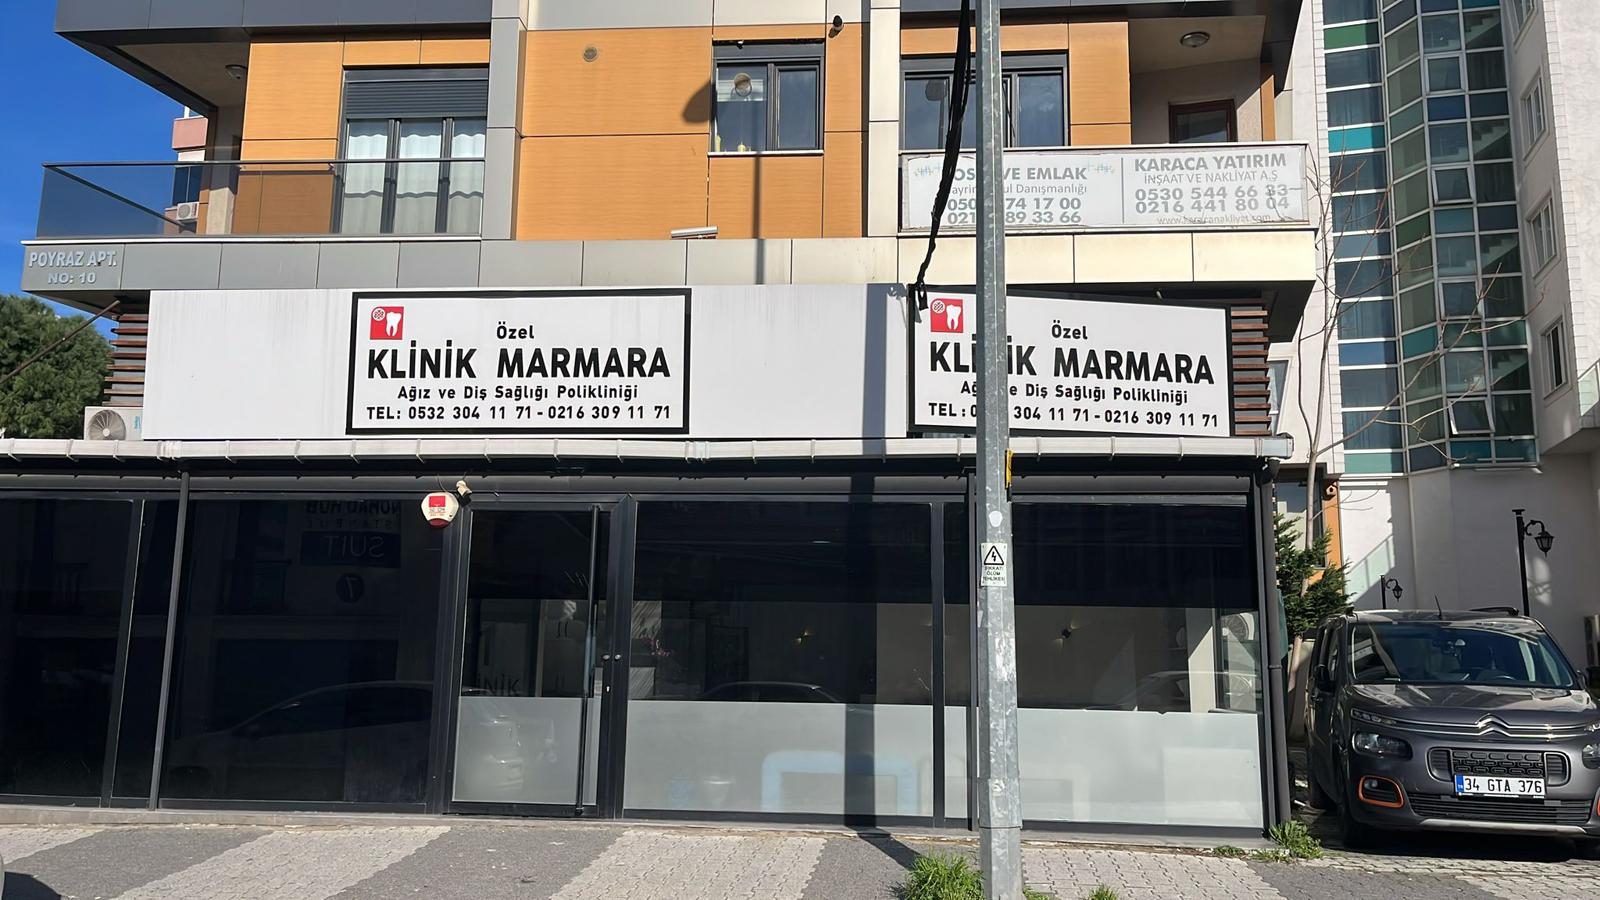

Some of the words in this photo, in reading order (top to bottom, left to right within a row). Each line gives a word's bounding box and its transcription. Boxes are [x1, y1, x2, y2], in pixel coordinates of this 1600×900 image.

[1134, 156, 1209, 172] KARACA
[1213, 153, 1287, 170] YATIRIM
[1027, 167, 1087, 180] EMLAK
[1144, 171, 1184, 186] İNŞAAT
[1187, 173, 1202, 184] VE
[1205, 169, 1257, 183] NAKLİYAT
[1016, 183, 1087, 196] Danışmanlığı
[1135, 187, 1184, 201] 0530
[1191, 186, 1228, 200] 544
[1234, 185, 1259, 198] 66
[947, 198, 977, 211] 050
[1005, 197, 1027, 210] 74
[1033, 198, 1053, 210] 17
[1059, 197, 1082, 210] 00
[1136, 200, 1185, 215] 0216
[1191, 199, 1226, 212] 441
[1235, 198, 1259, 211] 80
[1266, 197, 1290, 210] 04
[947, 211, 976, 225] 021
[1005, 211, 1027, 223] 89
[1032, 211, 1053, 224] 33
[1059, 211, 1082, 223] 66
[28, 250, 85, 268] POYRAZ
[87, 250, 118, 267] APT.
[48, 272, 74, 285] NO:
[79, 272, 97, 284] 10
[496, 321, 535, 339] Özel
[1051, 319, 1088, 340] Özel
[367, 340, 477, 379] KLİNİK
[496, 347, 670, 378] MARMARA
[930, 333, 1037, 376] KLİİK
[1053, 347, 1215, 384] MARMARA
[398, 386, 431, 401] Ağız
[439, 388, 456, 399] ve
[464, 386, 487, 401] Diş
[495, 385, 548, 401] Sağlığı
[557, 385, 638, 401] Polikliniği
[1025, 383, 1048, 399] Diş
[1055, 384, 1106, 402] Sağlığı
[1113, 386, 1188, 406] Polikliniği
[367, 407, 401, 420] TEL:
[408, 406, 445, 420] 0532
[453, 406, 480, 419] 304
[490, 406, 506, 419] 11
[591, 405, 620, 419] 309
[628, 405, 644, 419] 11
[654, 405, 671, 419] 71
[1014, 406, 1041, 421] 304
[1049, 407, 1064, 421] 11
[1146, 411, 1172, 425] 309
[1179, 412, 1195, 426] 11
[1202, 413, 1218, 427] 71
[1464, 778, 1480, 791] 34
[1487, 779, 1511, 792] GTA
[1518, 780, 1542, 793] 376
